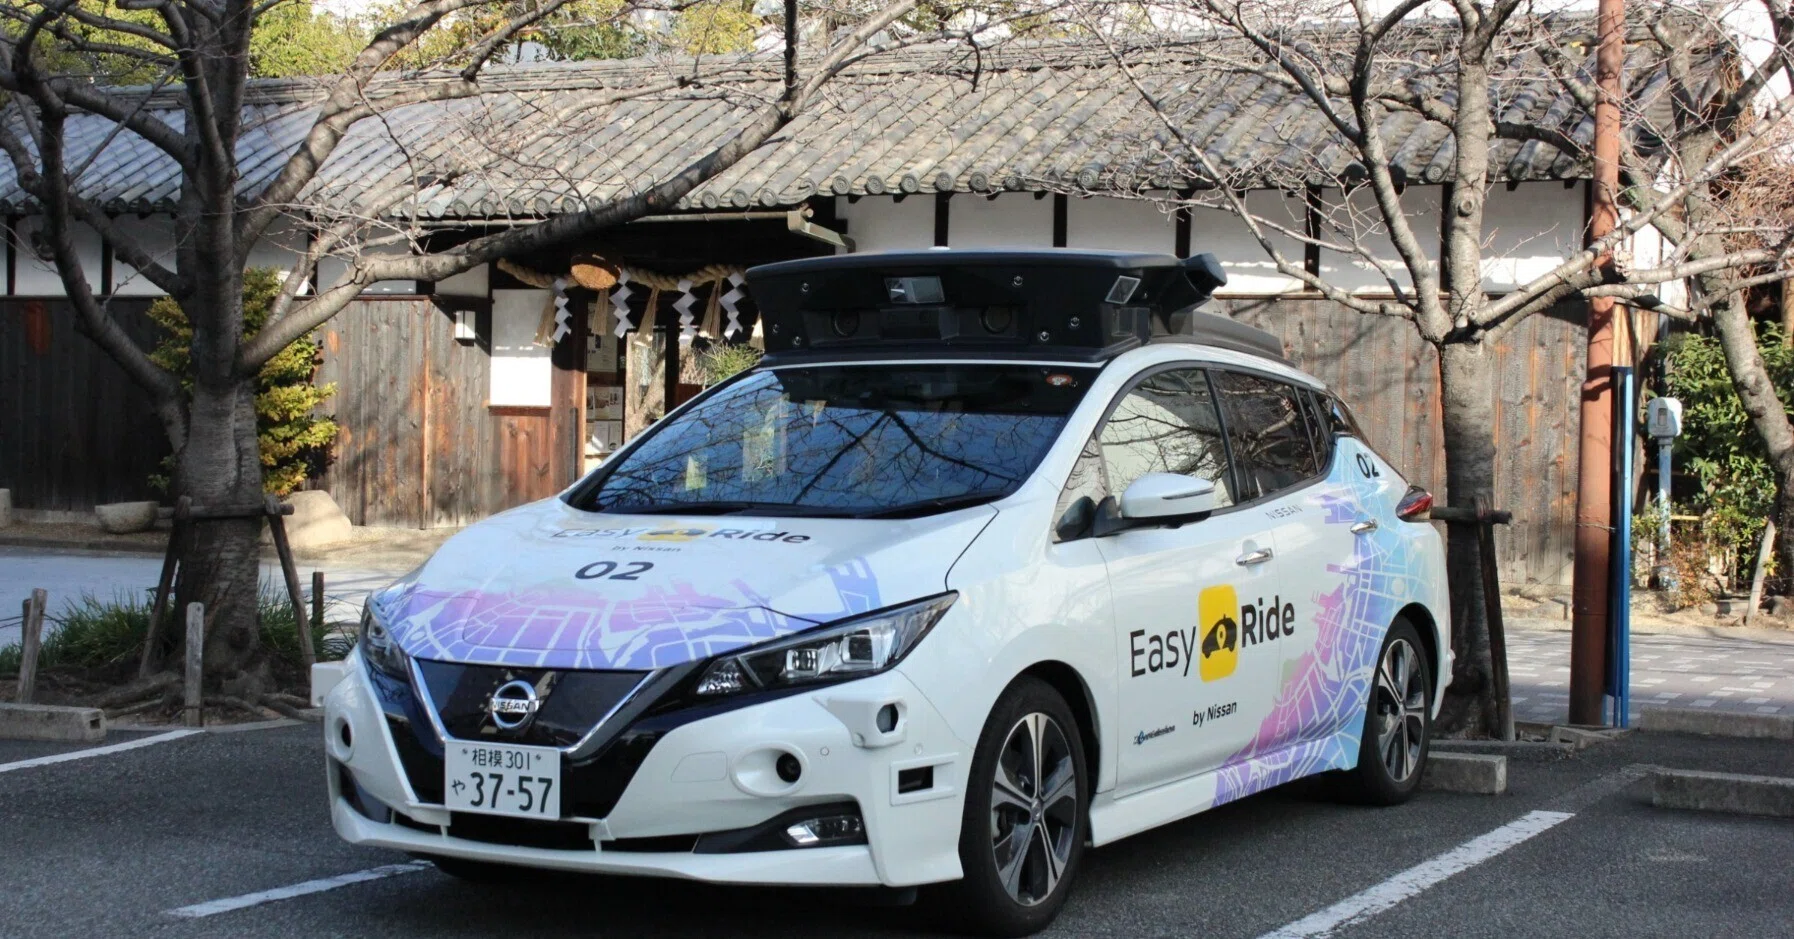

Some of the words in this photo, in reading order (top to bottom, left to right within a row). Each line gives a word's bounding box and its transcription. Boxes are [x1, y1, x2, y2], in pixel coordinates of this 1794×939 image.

[1356, 453, 1379, 479] 02
[1265, 504, 1303, 520] NISSAN
[551, 528, 648, 538] Easy
[709, 528, 811, 543] Ride
[574, 561, 654, 581] 02
[1130, 626, 1196, 678] Easy
[1241, 595, 1295, 648] Ride
[490, 700, 530, 712] NISSAN
[1192, 710, 1205, 728] by
[1207, 702, 1237, 721] Nissan
[451, 779, 466, 797] や
[470, 771, 553, 814] 37-57
